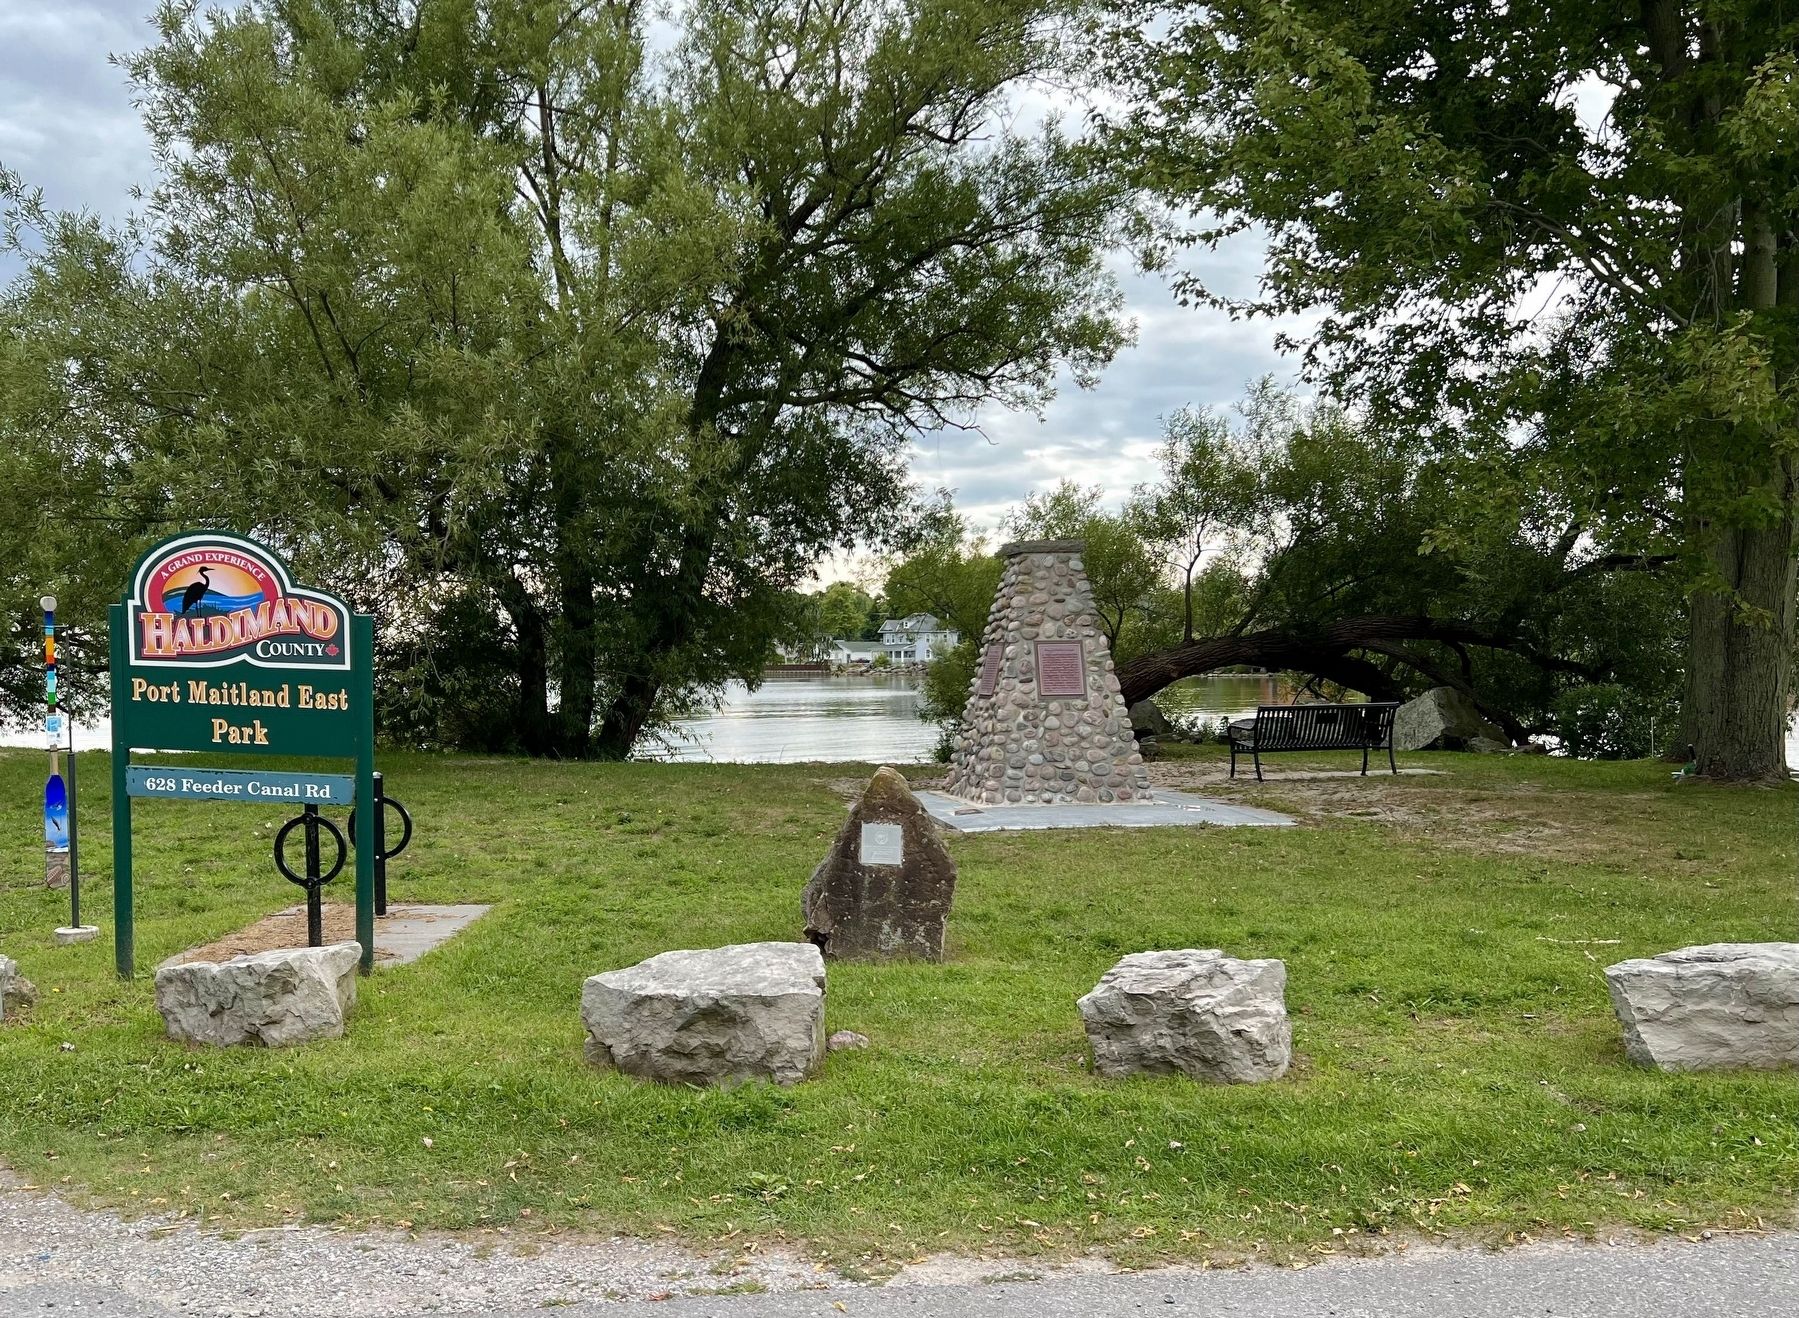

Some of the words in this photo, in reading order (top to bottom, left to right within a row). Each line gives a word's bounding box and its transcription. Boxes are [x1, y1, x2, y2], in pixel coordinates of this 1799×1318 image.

[160, 569, 169, 580] A
[167, 553, 203, 573] GRAND
[205, 553, 266, 581] EXPERIENCE
[141, 599, 338, 656] HALDIMAND
[255, 640, 325, 658] COUNTY
[131, 678, 180, 703] Port
[187, 680, 290, 708] Maitland
[298, 685, 348, 710] East
[211, 718, 269, 745] Park
[146, 777, 176, 792] 628
[181, 779, 242, 794] Feeder
[247, 781, 299, 797] Canal
[305, 784, 331, 798] Rd
